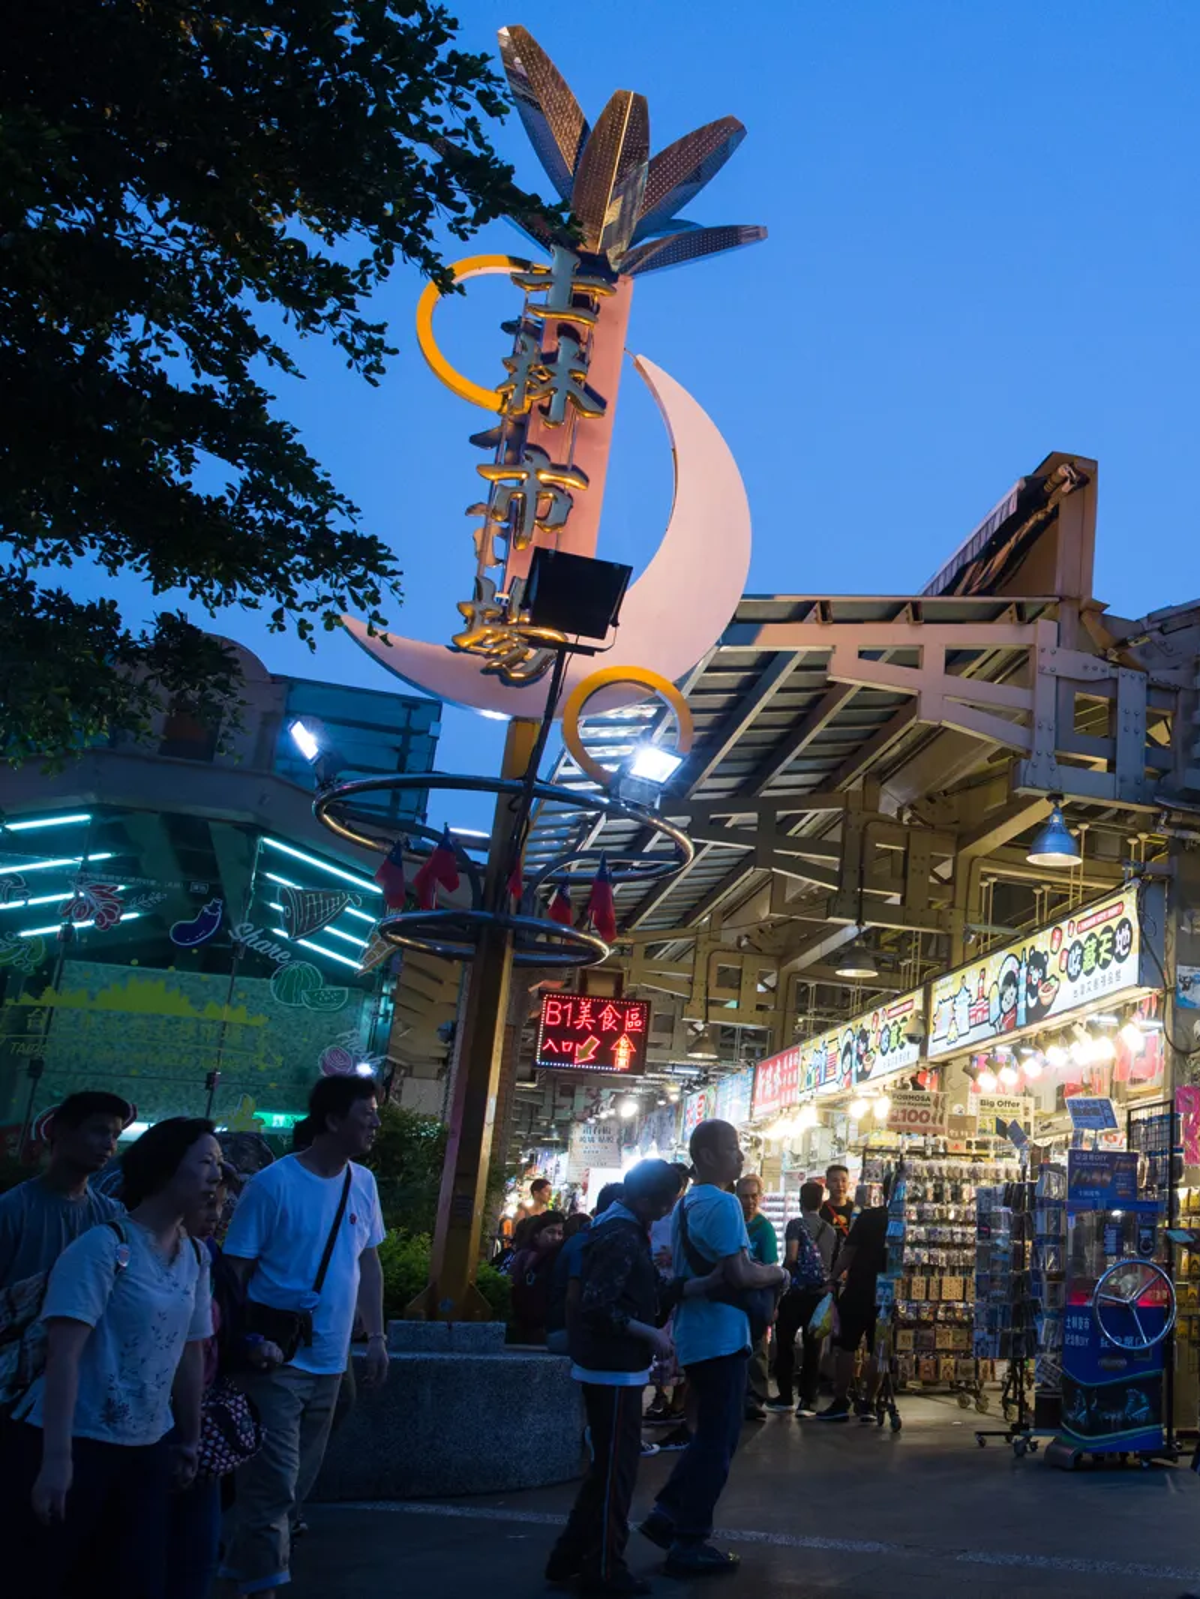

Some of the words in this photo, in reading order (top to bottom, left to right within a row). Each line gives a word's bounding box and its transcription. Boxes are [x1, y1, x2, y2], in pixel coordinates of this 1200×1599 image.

[227, 921, 292, 964] Share
[1067, 919, 1133, 981] 收藏天地
[545, 1000, 643, 1033] B1美食區
[542, 1038, 573, 1053] 入口
